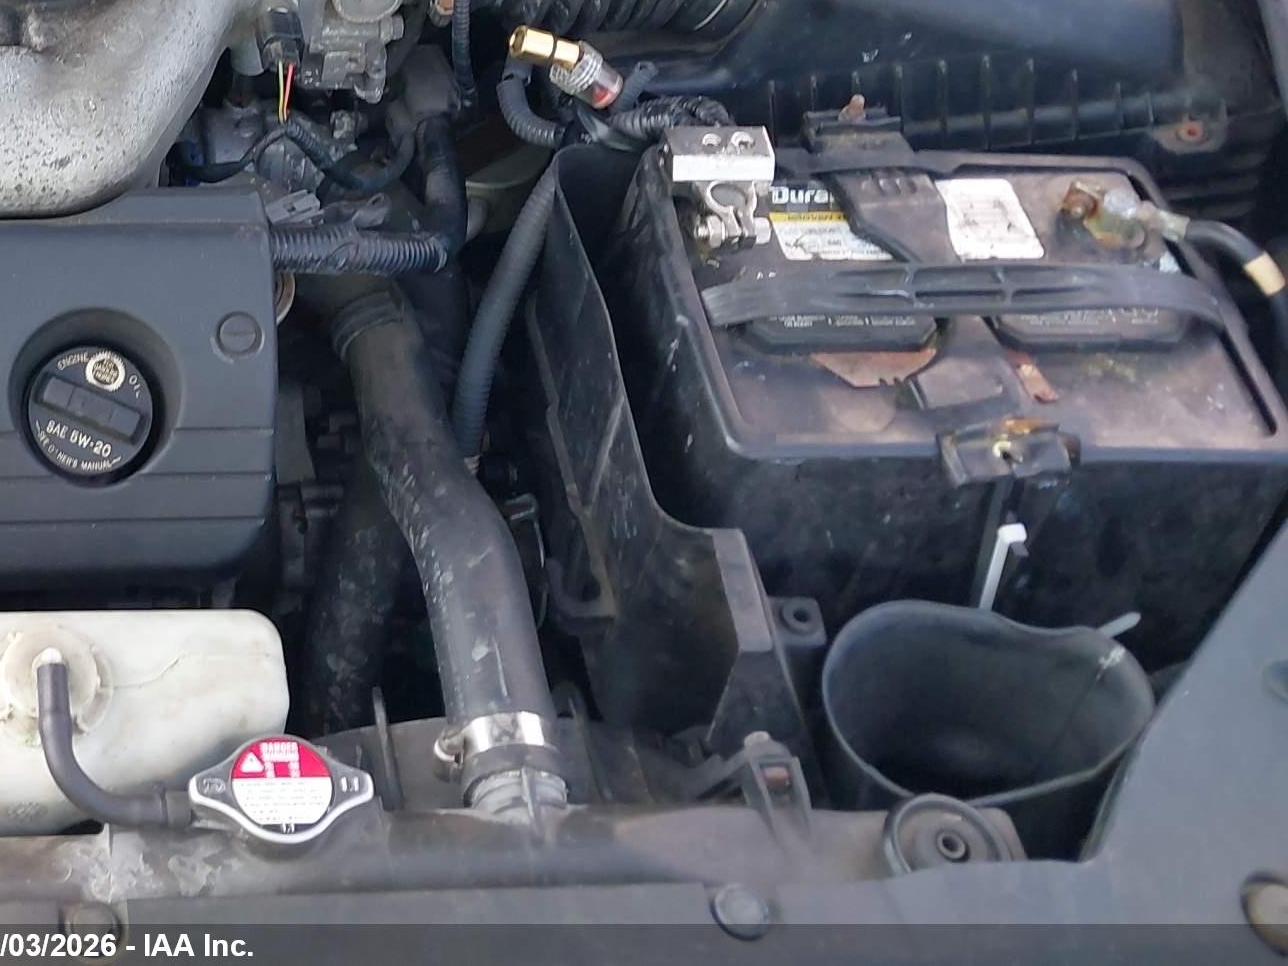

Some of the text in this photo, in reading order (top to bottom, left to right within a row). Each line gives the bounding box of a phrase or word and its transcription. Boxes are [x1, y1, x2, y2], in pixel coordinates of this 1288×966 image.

[128, 374, 142, 399] OIL
[46, 420, 69, 439] SAE
[80, 459, 113, 471] MANUAL
[261, 742, 298, 754] DANGER
